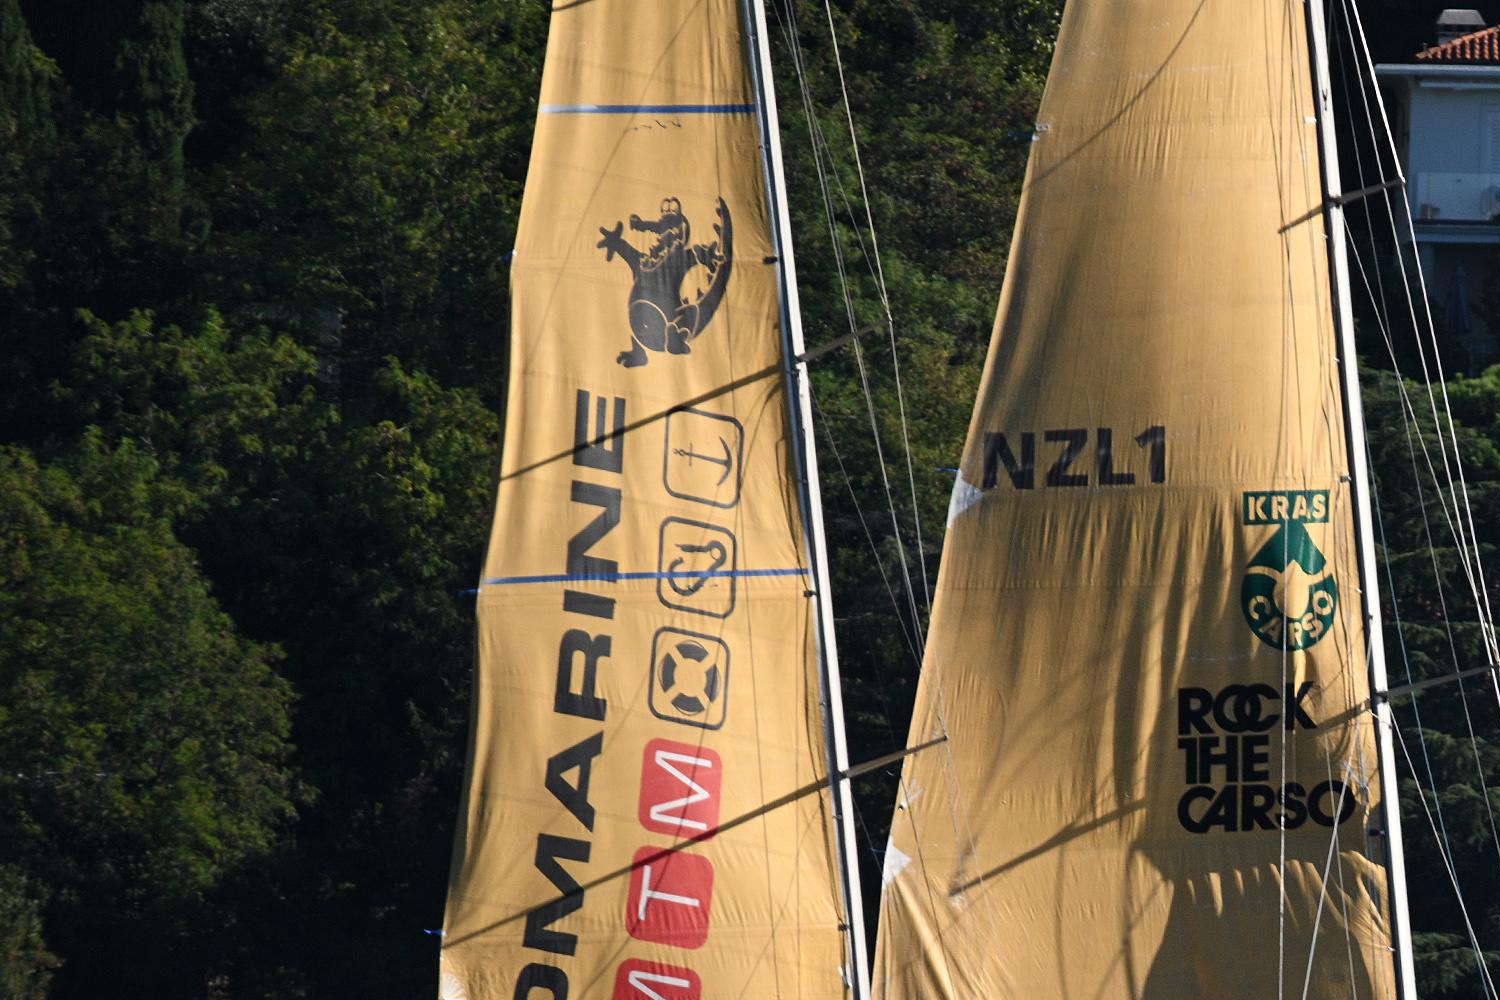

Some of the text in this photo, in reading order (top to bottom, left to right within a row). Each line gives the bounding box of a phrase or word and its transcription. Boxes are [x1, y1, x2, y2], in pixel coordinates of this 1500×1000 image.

[982, 425, 1166, 490] NZL1
[1247, 494, 1327, 521] KRAS
[1248, 590, 1334, 647] CARSO
[1178, 681, 1318, 734] ROCK
[1178, 735, 1270, 785] THE
[1178, 780, 1358, 834] CARSO
